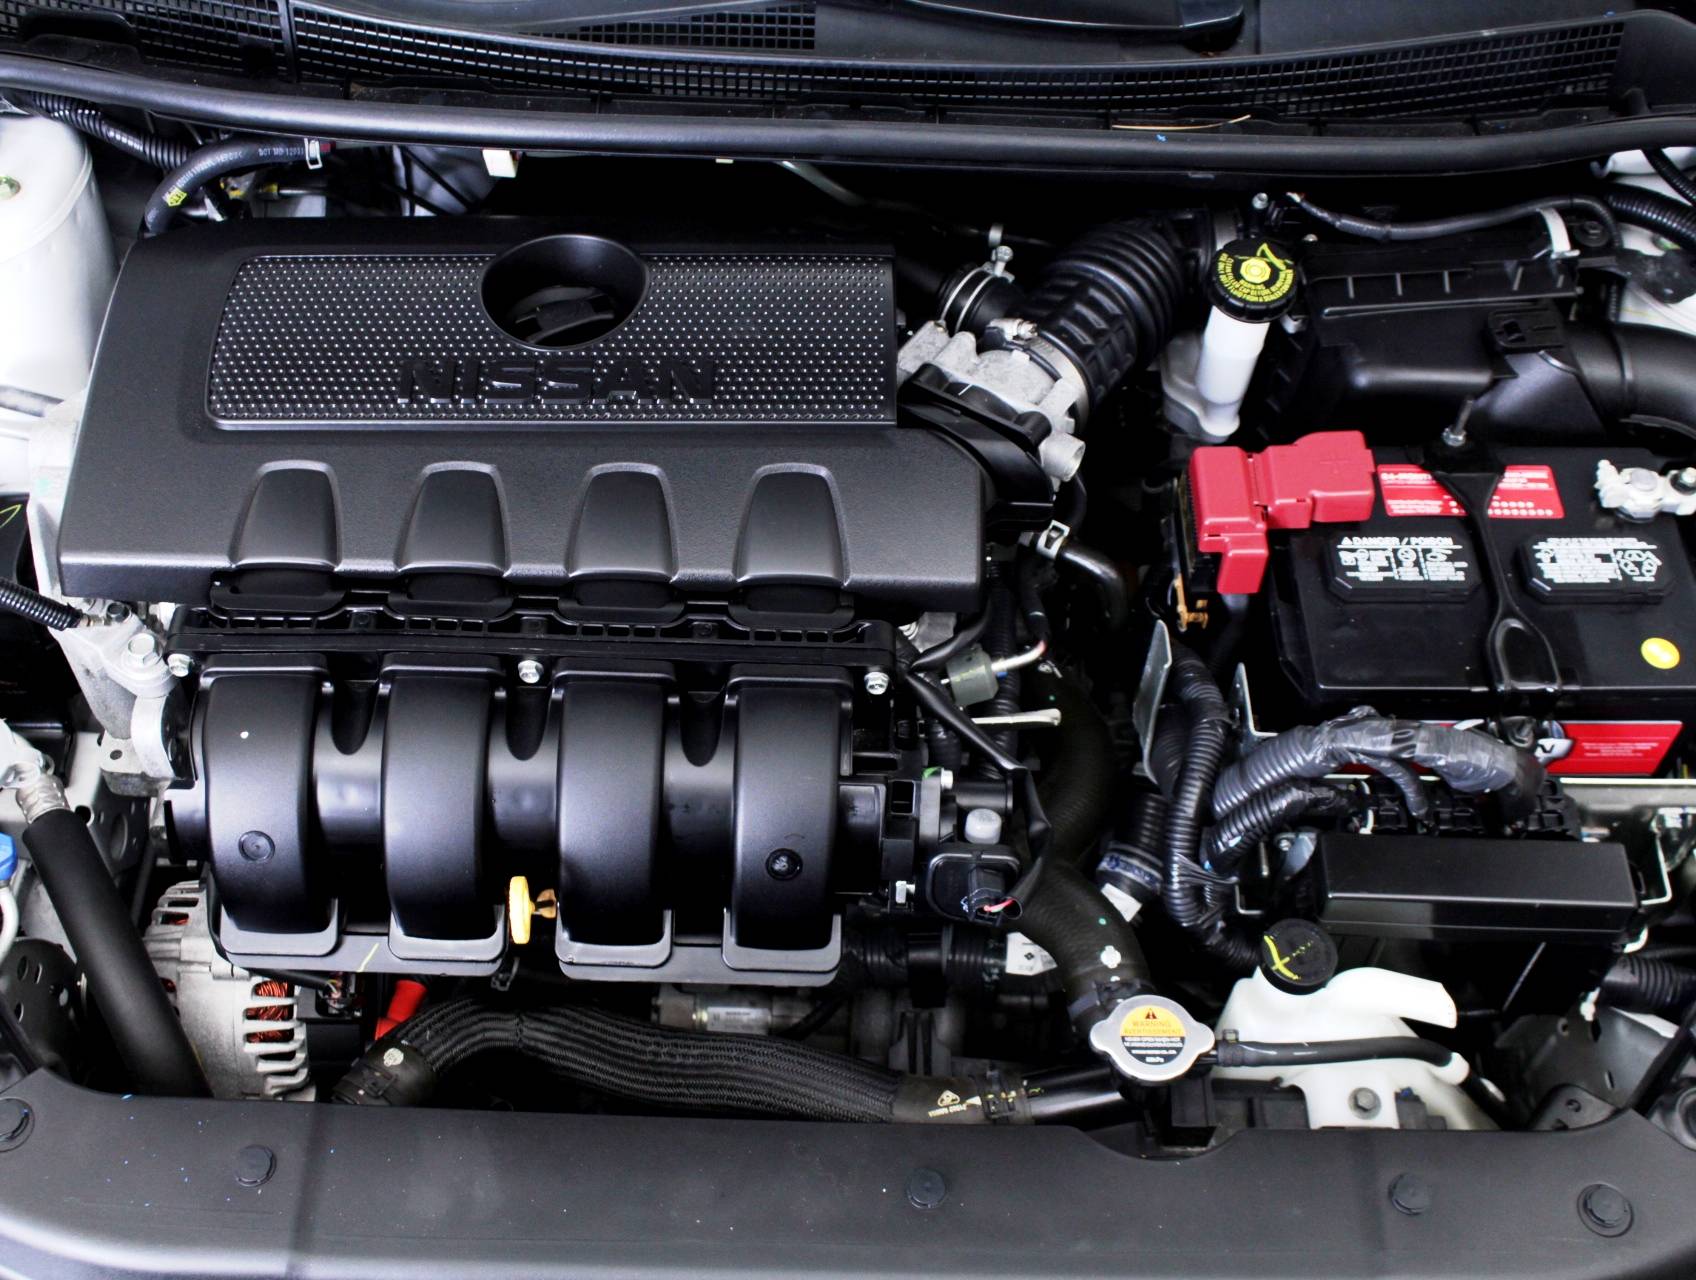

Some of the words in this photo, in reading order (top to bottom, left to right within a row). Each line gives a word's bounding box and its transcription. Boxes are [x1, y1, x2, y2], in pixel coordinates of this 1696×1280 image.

[397, 359, 713, 403] NISSAN
[1353, 537, 1400, 546] DANGER
[1410, 537, 1454, 546] POISON
[1132, 1020, 1171, 1028] WARNING
